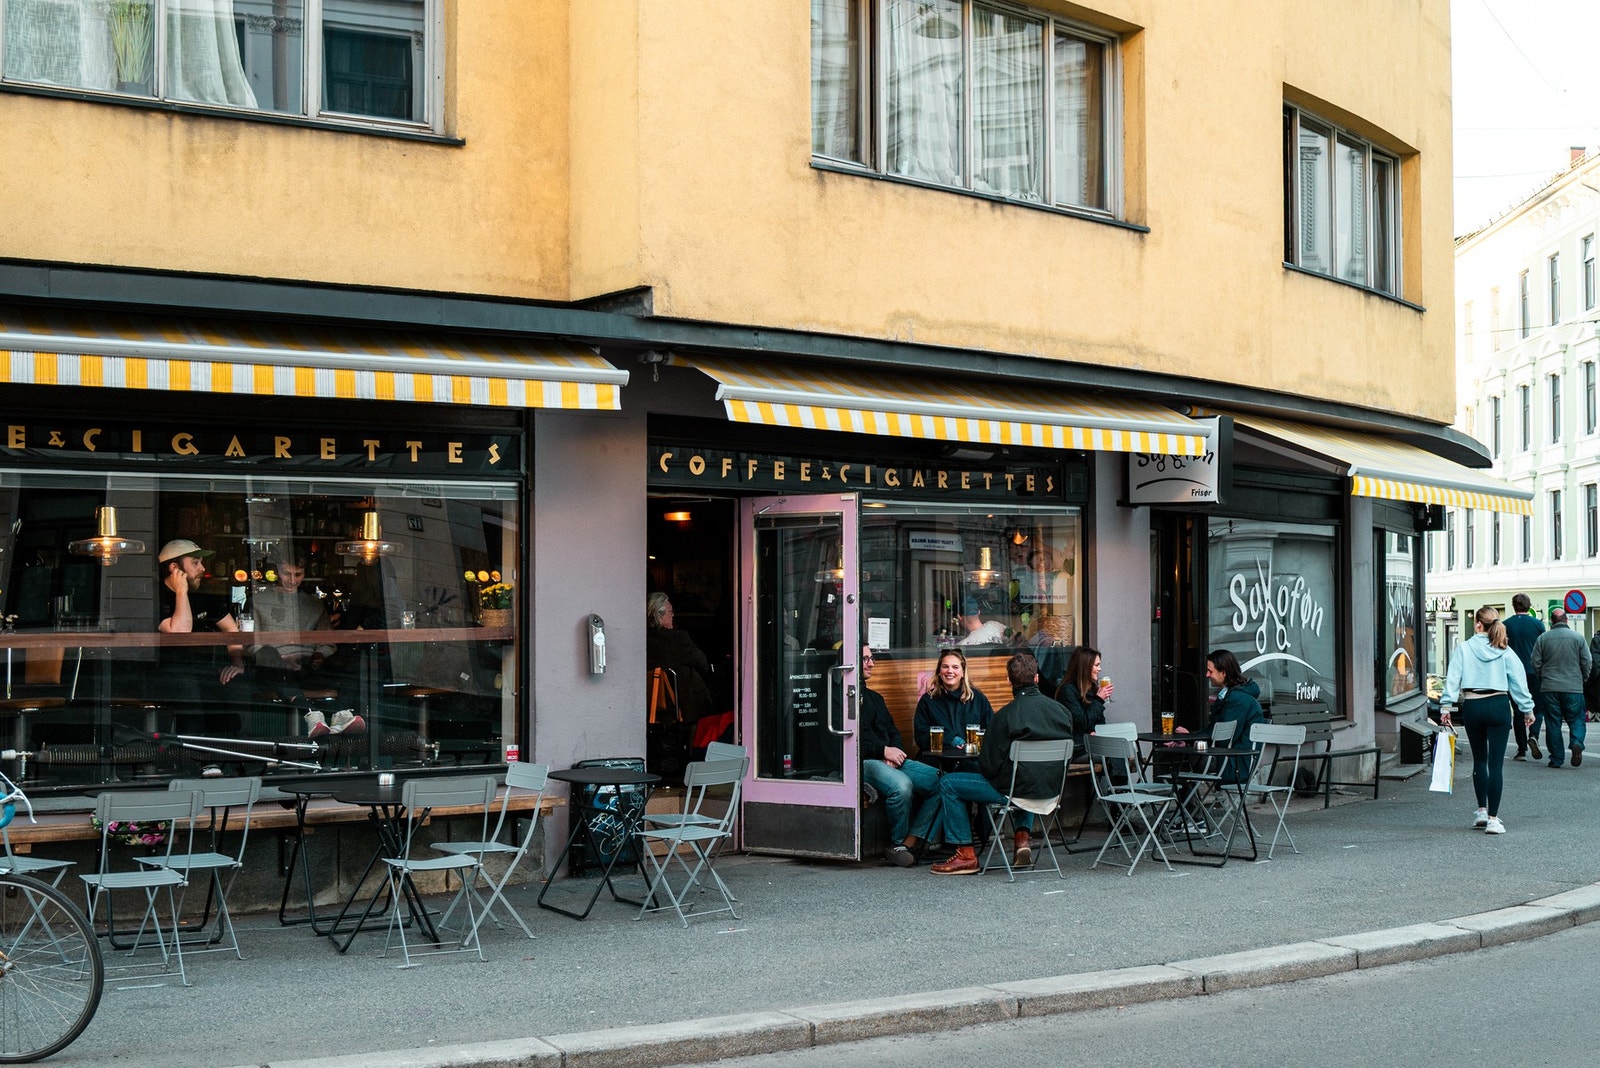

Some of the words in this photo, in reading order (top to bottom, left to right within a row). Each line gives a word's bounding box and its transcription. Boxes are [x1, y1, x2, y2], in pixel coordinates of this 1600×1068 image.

[83, 428, 501, 465] CIGARETTES
[659, 452, 811, 482] COFFEE
[839, 464, 1055, 492] CIGARETTES
[1191, 488, 1212, 497] Frisør
[1296, 681, 1321, 701] Frisør
